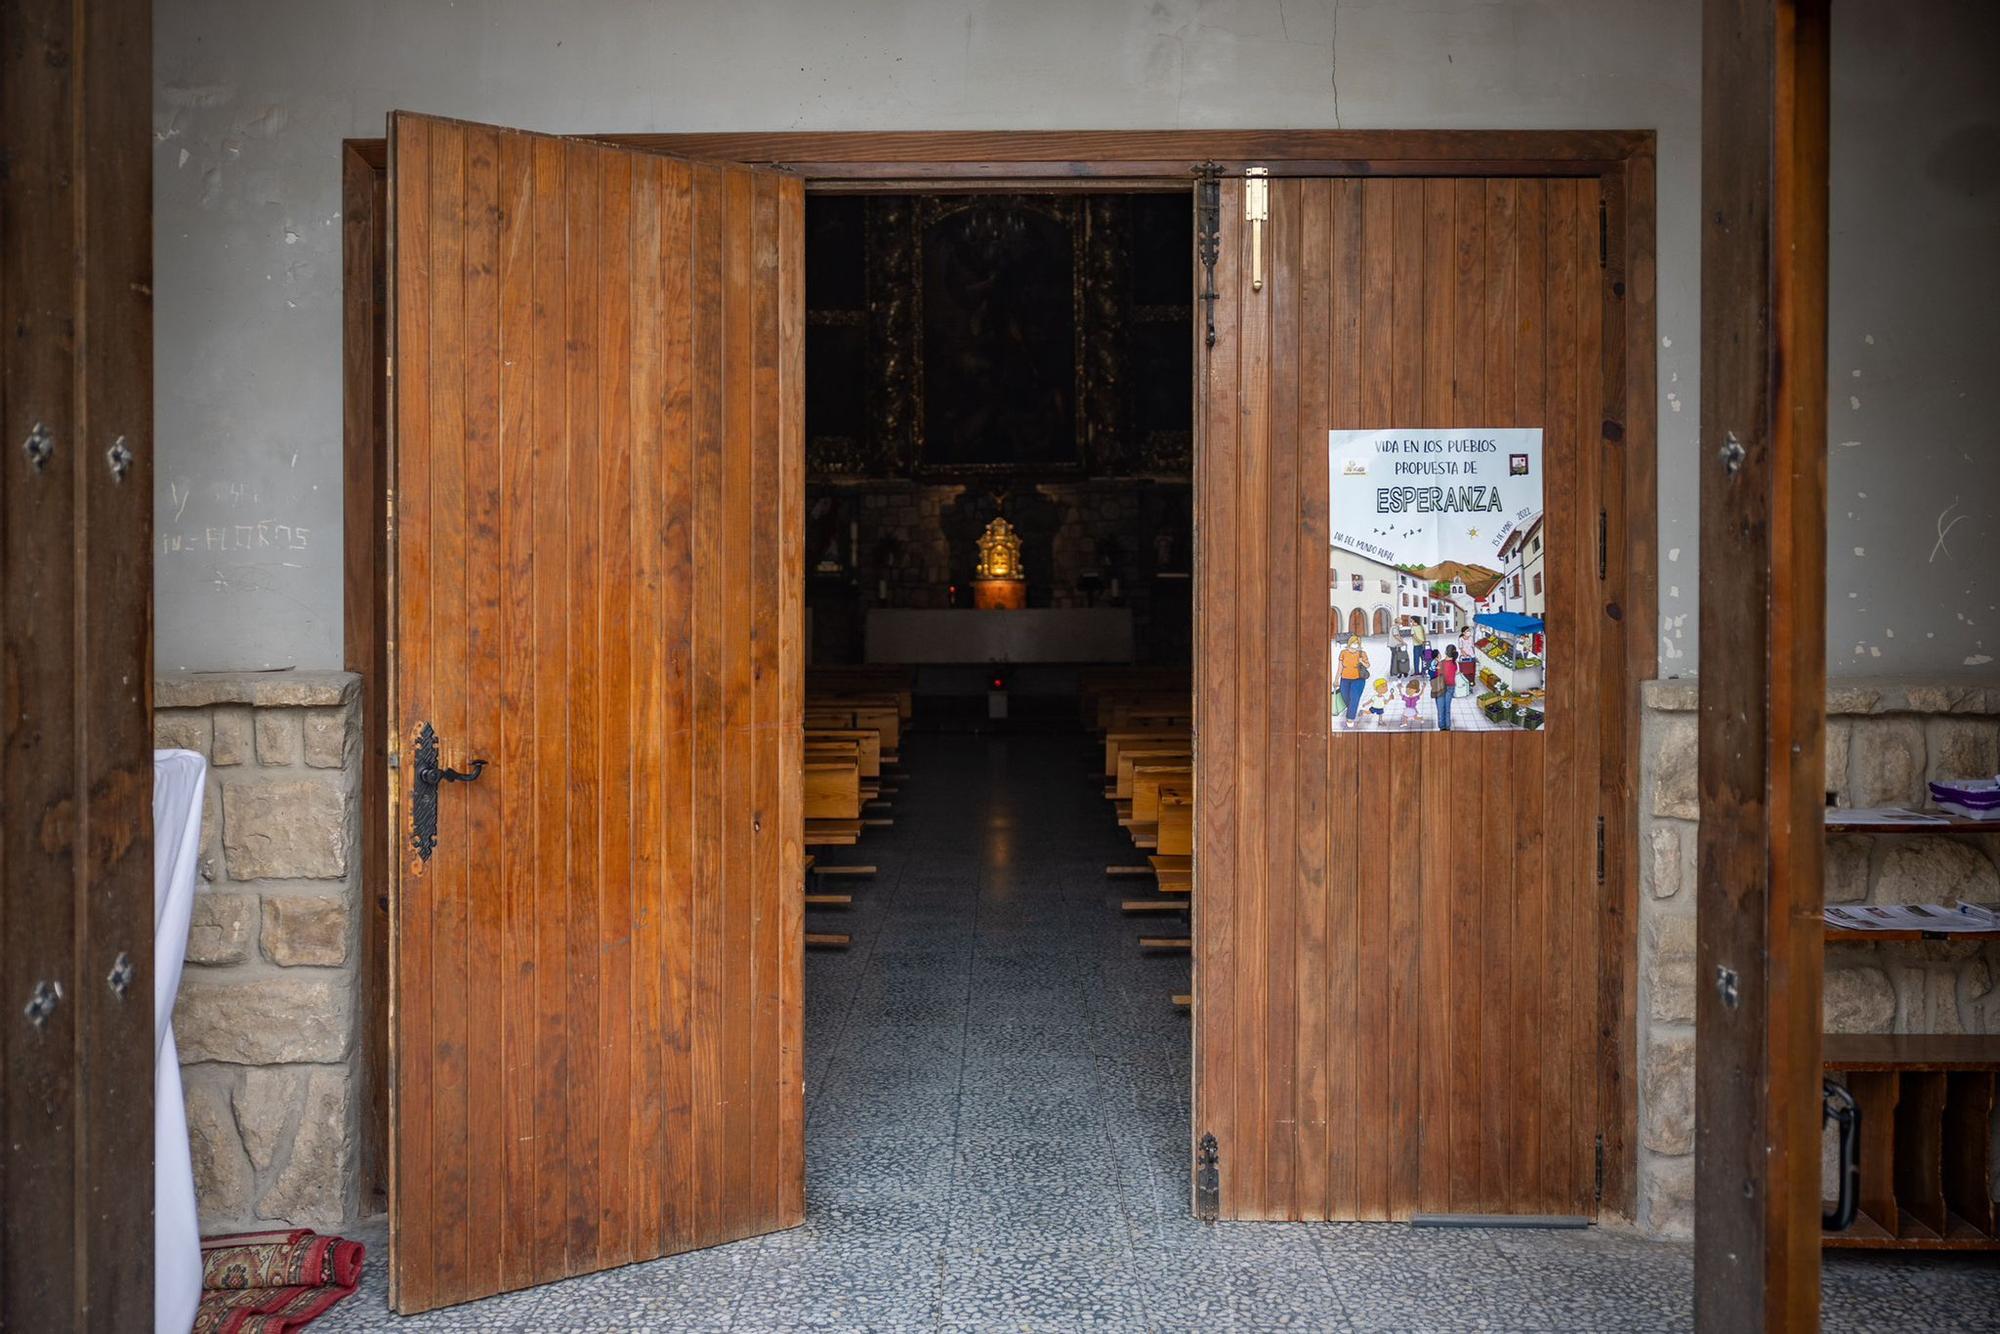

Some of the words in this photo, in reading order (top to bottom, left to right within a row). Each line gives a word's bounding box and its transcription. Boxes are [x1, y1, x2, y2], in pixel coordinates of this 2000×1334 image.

[1375, 439, 1399, 453] VIDA
[1404, 439, 1419, 453] EN
[1423, 439, 1443, 453] LOS
[1448, 439, 1497, 453] PUEBLOS
[1394, 460, 1459, 475] PROPUESTA
[1463, 460, 1478, 475] DE
[1376, 486, 1503, 513] ESPERANZA
[1516, 507, 1532, 520] 2022
[1356, 539, 1378, 554] MUNDO
[1377, 547, 1395, 561] RURAL
